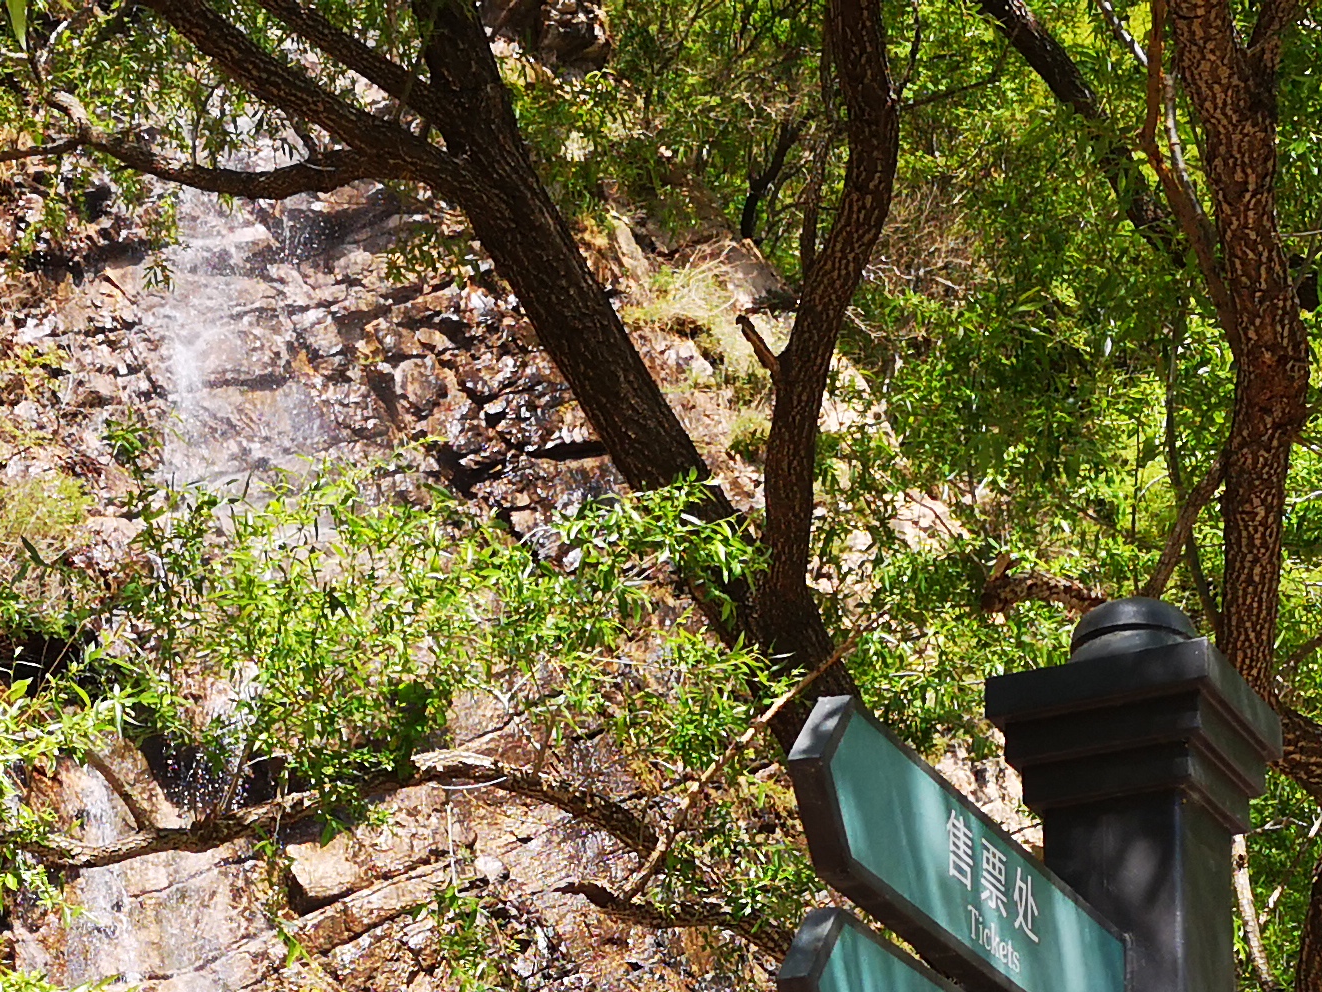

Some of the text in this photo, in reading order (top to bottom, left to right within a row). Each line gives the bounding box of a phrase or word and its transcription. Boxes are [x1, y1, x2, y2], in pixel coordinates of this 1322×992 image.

[946, 810, 1040, 943] 售票处
[967, 904, 1021, 972] Tickets
